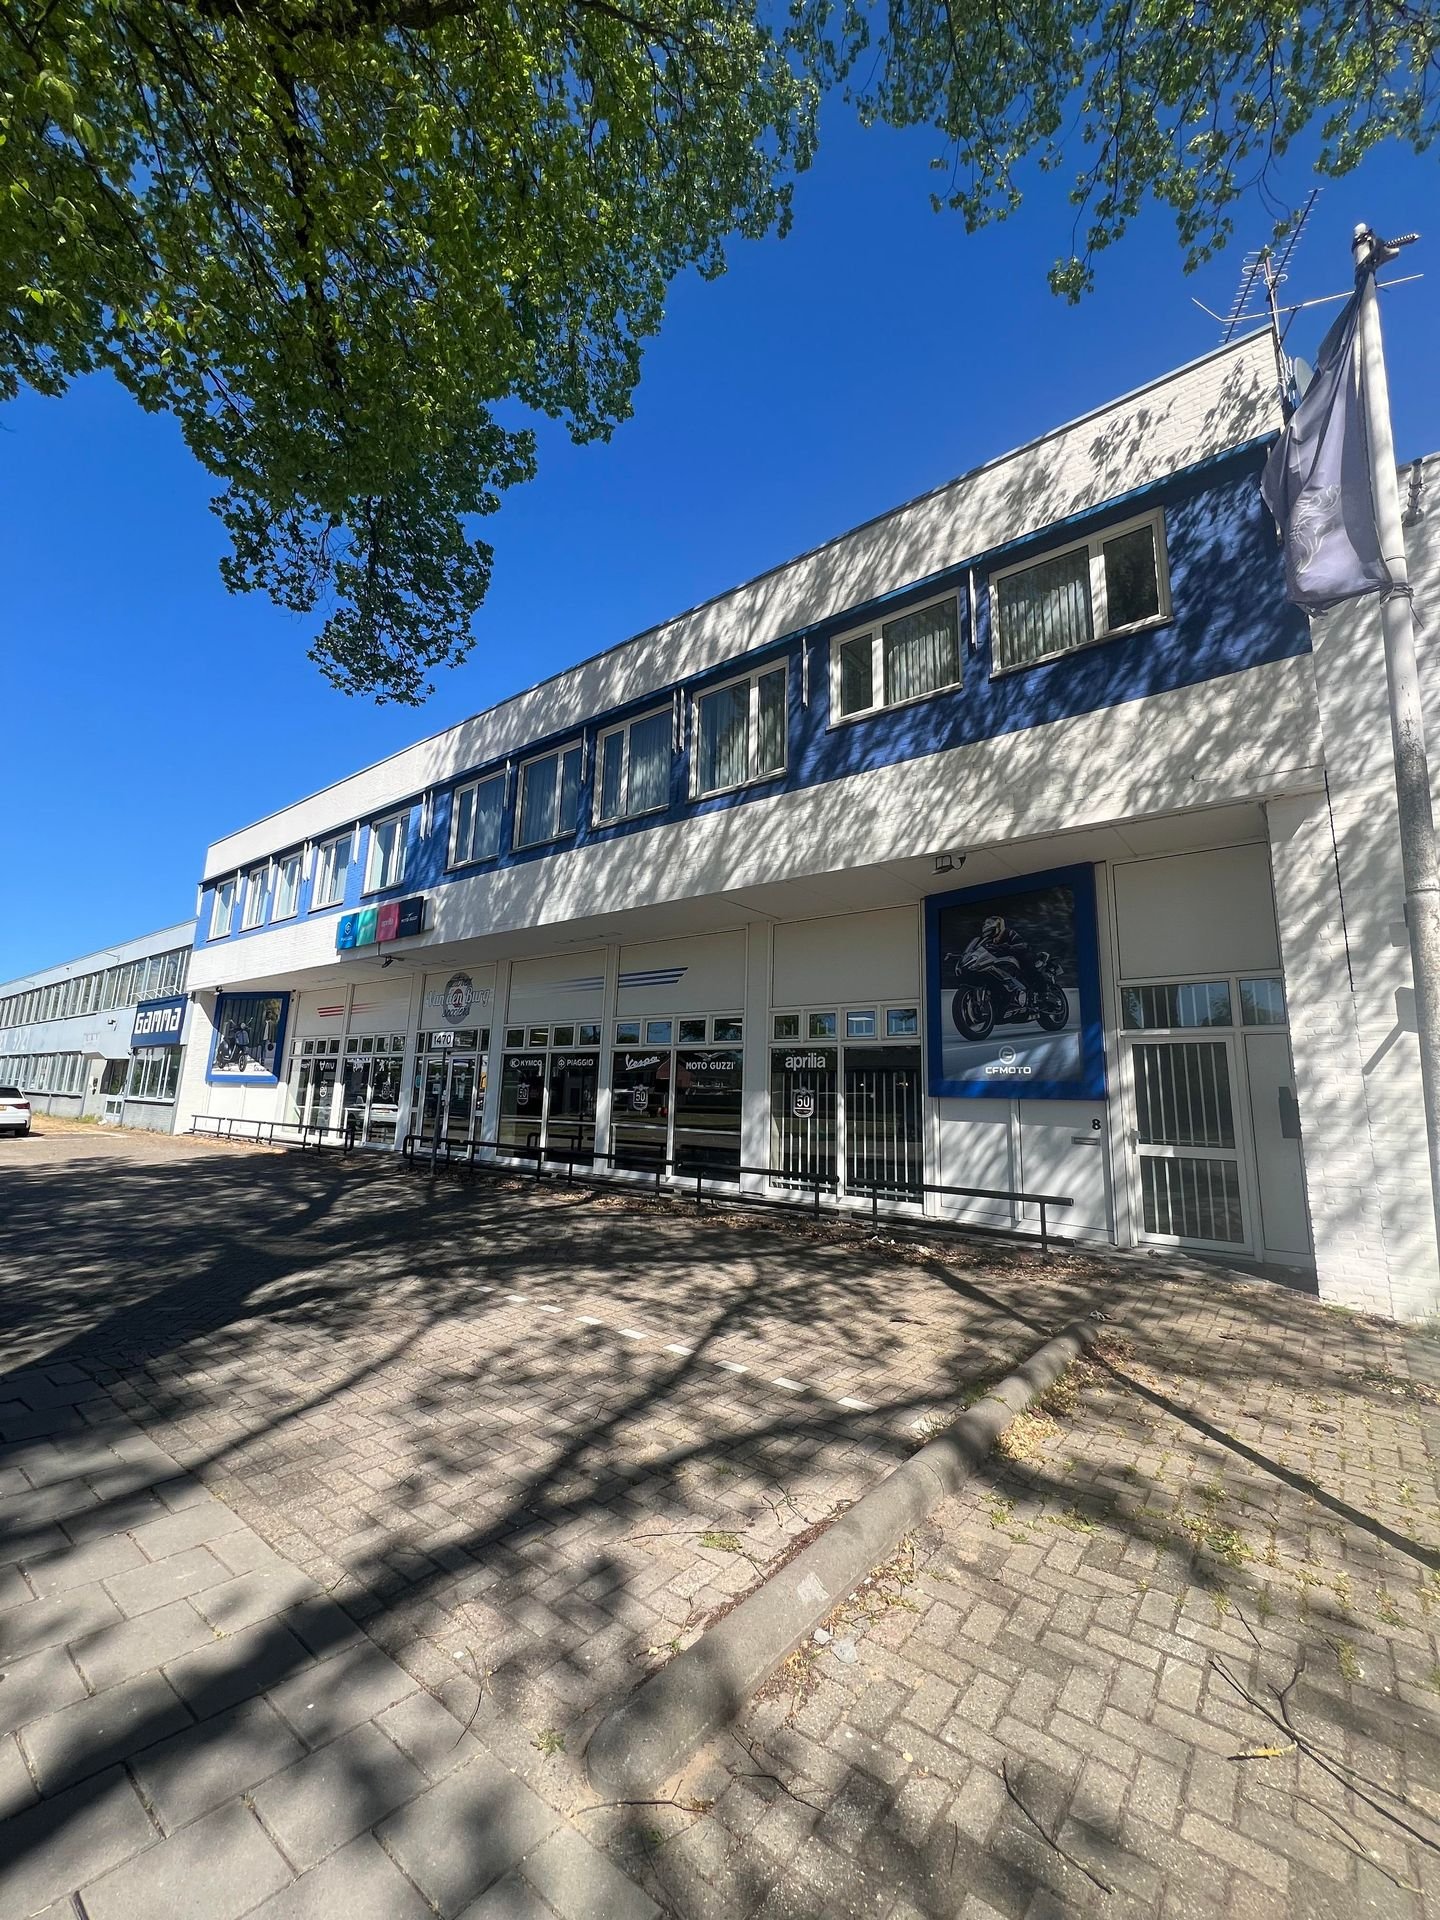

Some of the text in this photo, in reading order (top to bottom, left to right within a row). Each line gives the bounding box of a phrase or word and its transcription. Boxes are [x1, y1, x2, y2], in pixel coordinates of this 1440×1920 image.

[465, 986, 490, 1007] Burg
[134, 1007, 182, 1035] GAMMA
[434, 1034, 452, 1045] 1470
[626, 1053, 660, 1071] Vespa
[686, 1061, 734, 1070] MOTO GUZZI
[785, 1052, 826, 1071] aprilia
[636, 1092, 646, 1102] 50
[797, 1096, 810, 1108] 50
[1092, 1118, 1101, 1130] 8
